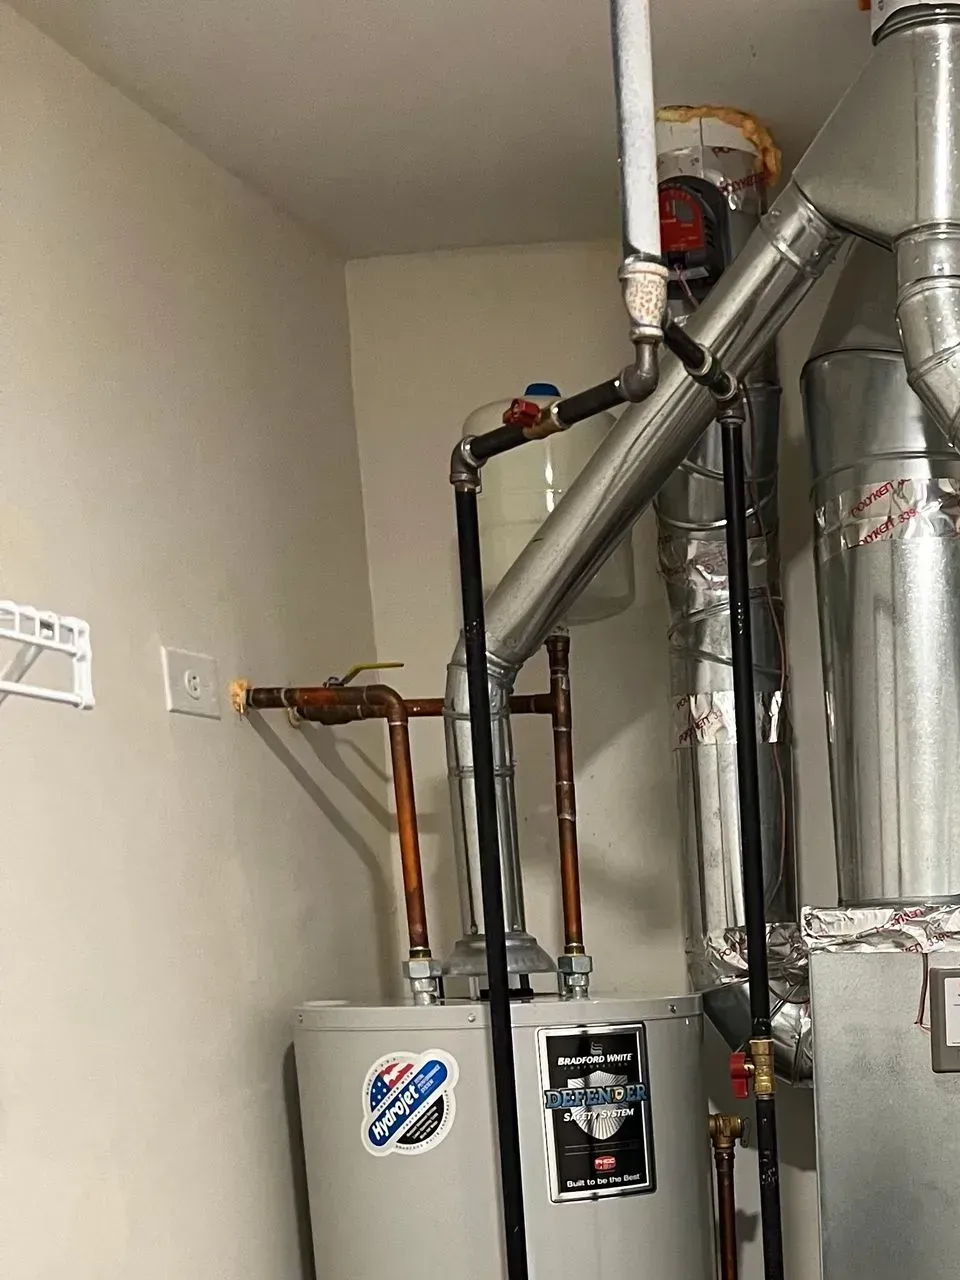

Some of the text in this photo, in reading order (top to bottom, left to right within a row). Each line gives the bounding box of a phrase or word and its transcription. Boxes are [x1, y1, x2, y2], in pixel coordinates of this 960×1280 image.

[850, 480, 895, 518] POLYKEN
[898, 508, 919, 524] 339
[557, 1053, 633, 1066] BRADFORD WHITE
[545, 1083, 648, 1109] DEFENDER
[371, 1083, 419, 1140] Hydrojet
[563, 1108, 635, 1122] SAFETY SYSTEM
[566, 1173, 641, 1188] Built to be the Best
